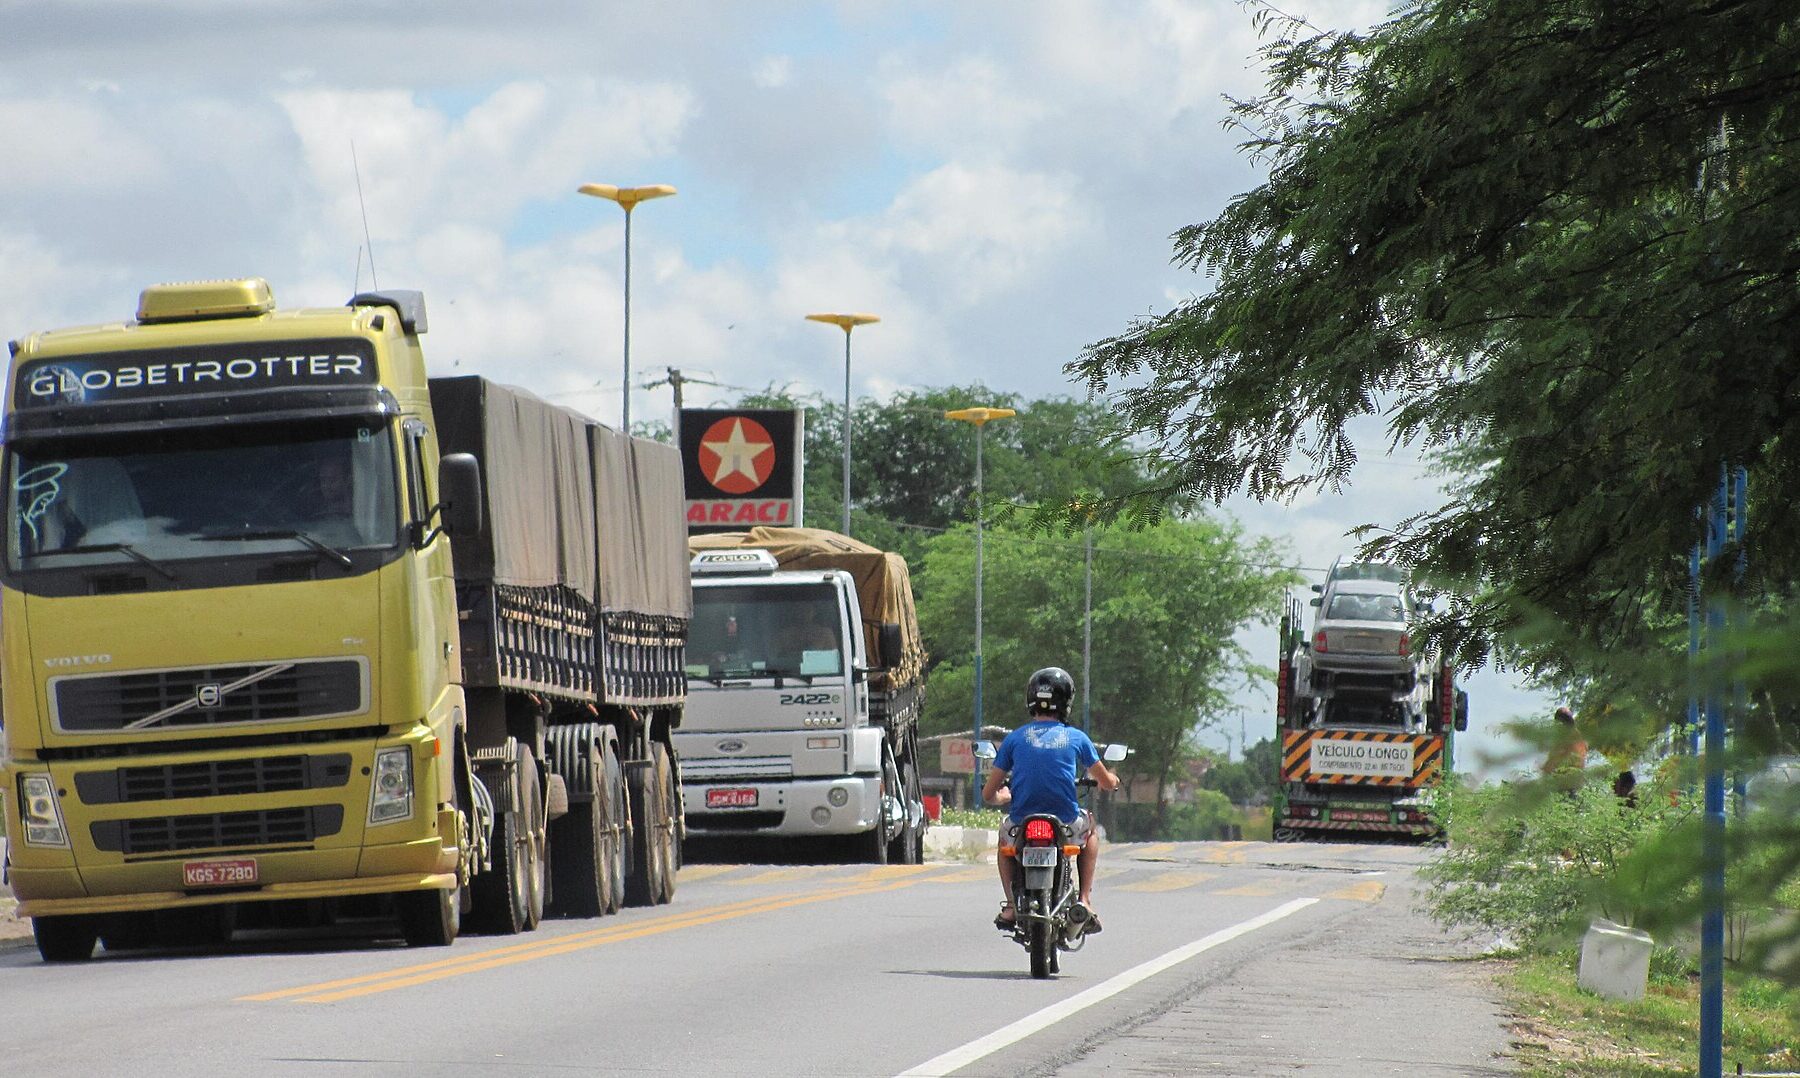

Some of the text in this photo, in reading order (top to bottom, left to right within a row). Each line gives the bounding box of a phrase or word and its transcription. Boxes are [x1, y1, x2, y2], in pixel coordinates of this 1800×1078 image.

[30, 354, 362, 397] GLOBETROTTER
[44, 654, 112, 667] VOLVO
[1368, 747, 1408, 760] LONGO
